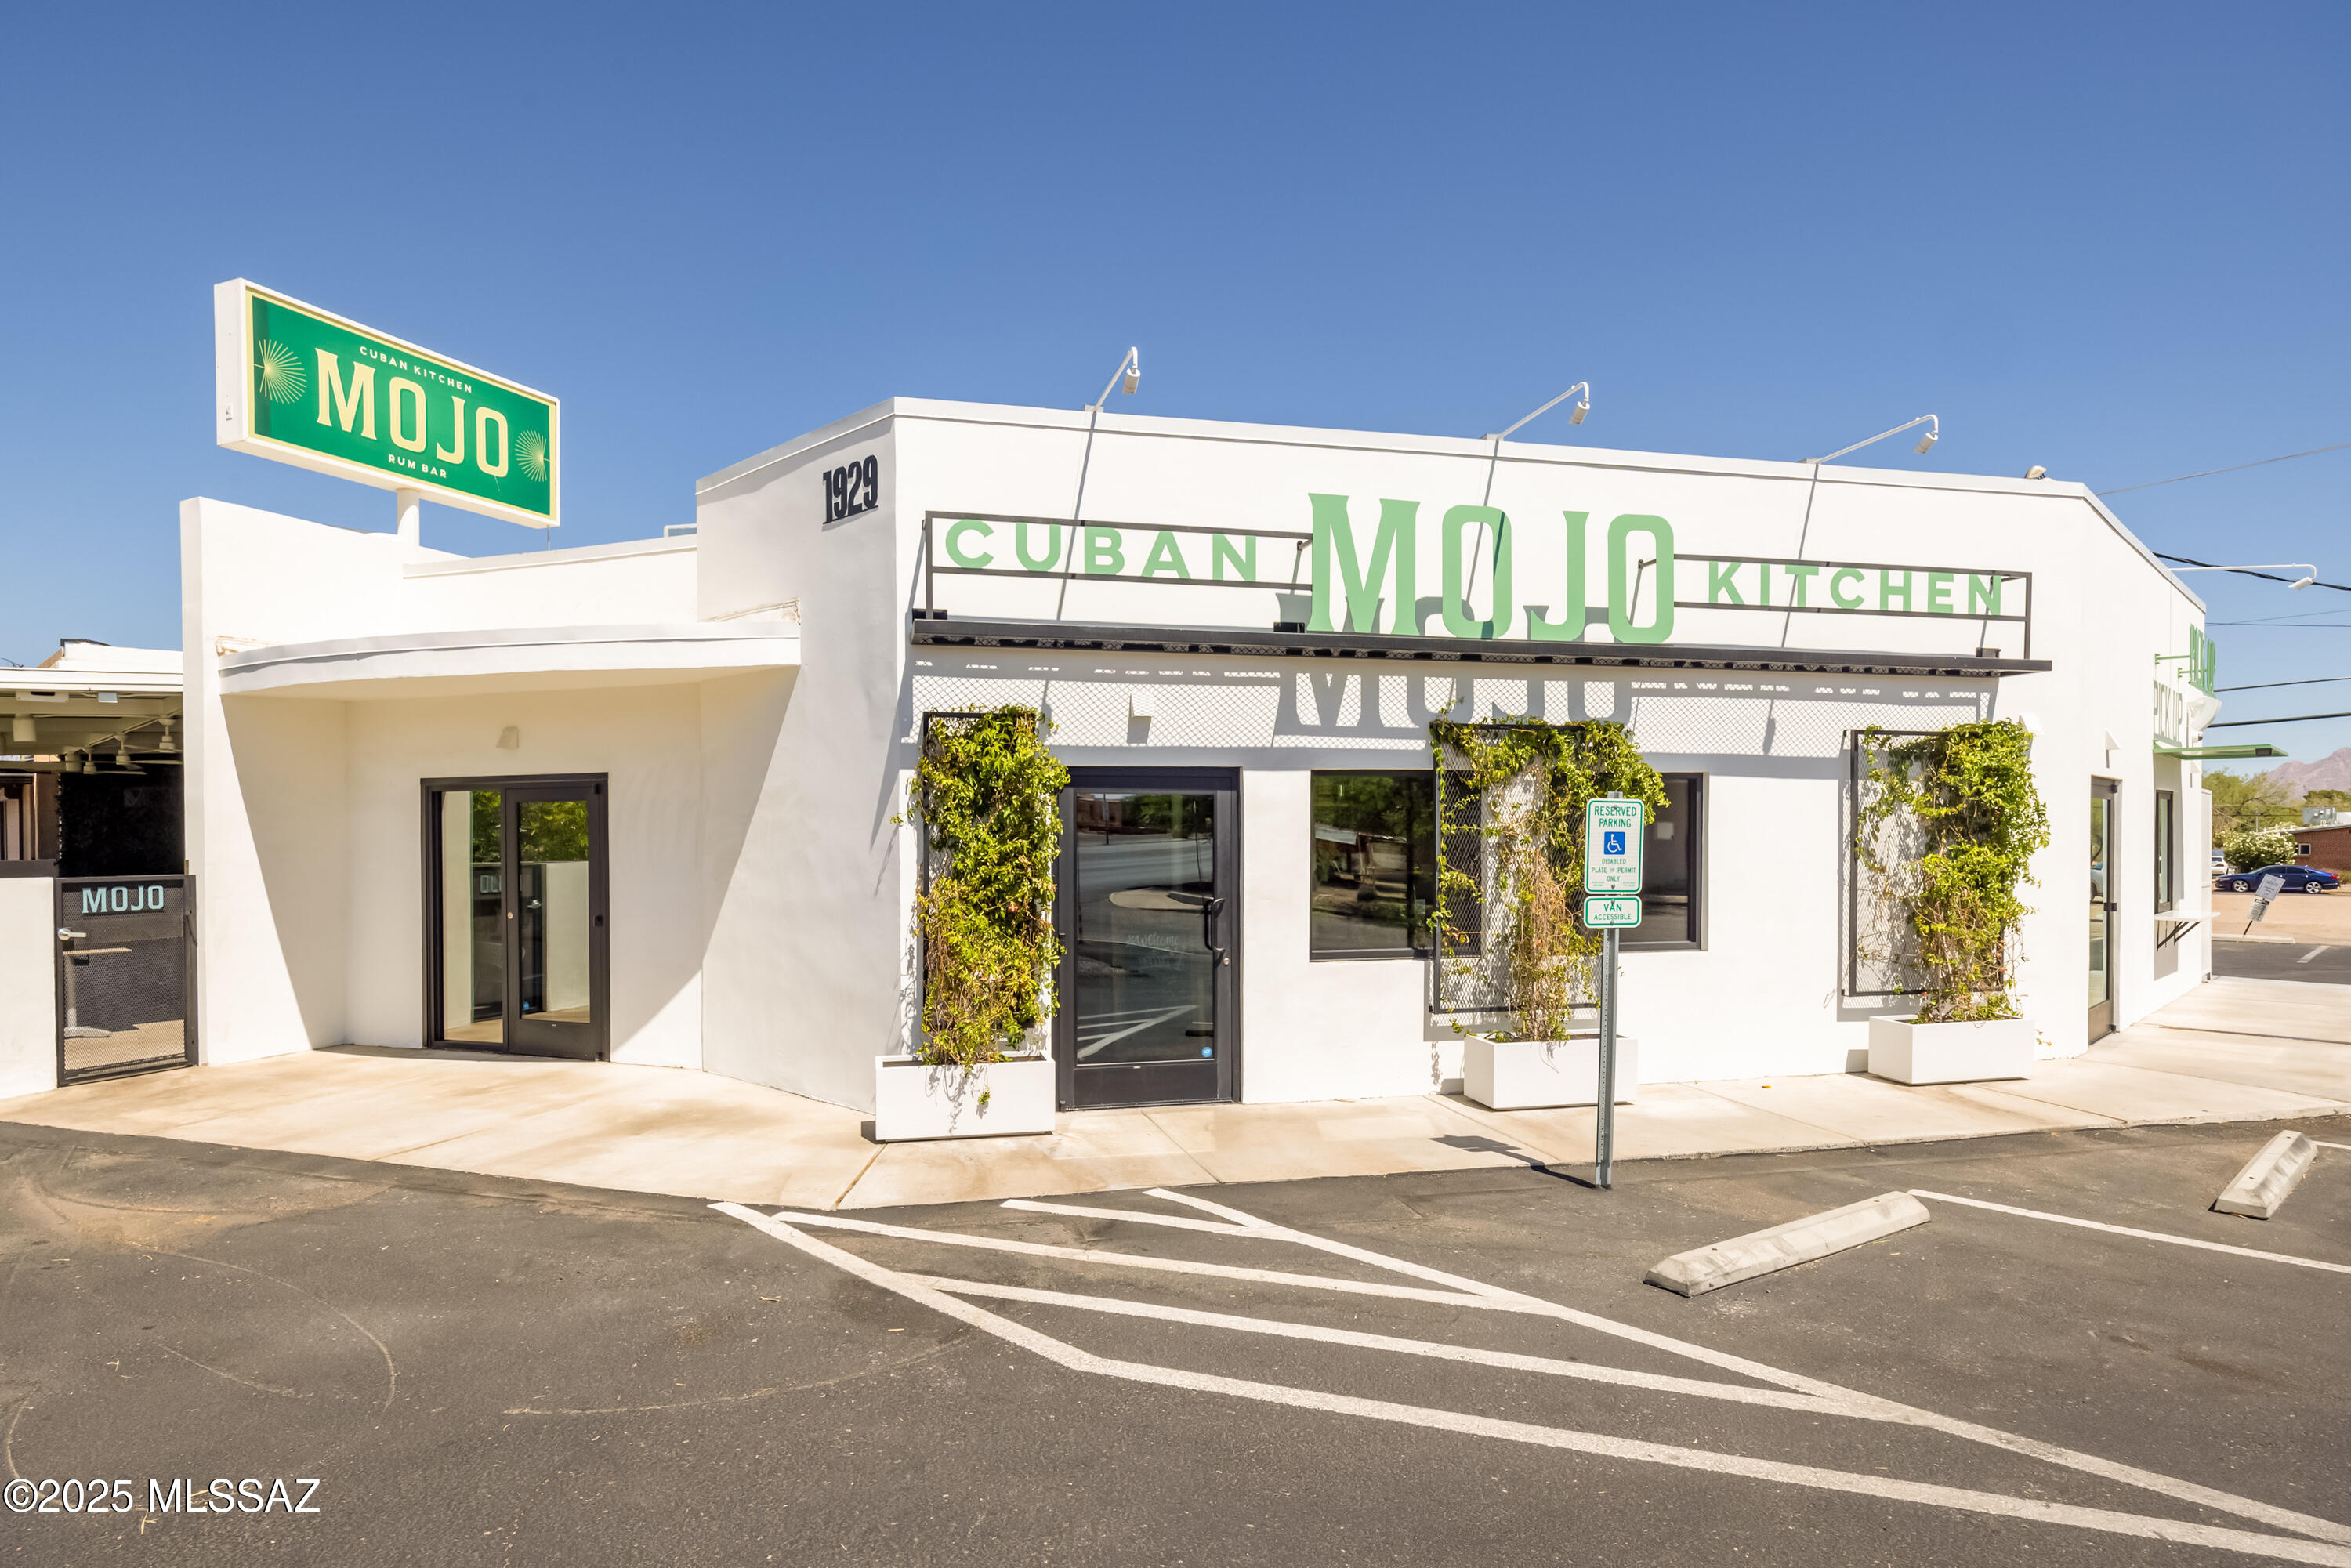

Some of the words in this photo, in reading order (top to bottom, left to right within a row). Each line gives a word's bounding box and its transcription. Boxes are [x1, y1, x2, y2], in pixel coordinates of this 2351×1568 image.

[360, 346, 408, 371] CUBAN
[413, 365, 473, 394] KITCHEN
[315, 347, 509, 478] MOJO
[388, 454, 417, 471] RUM
[422, 463, 447, 480] BAR
[823, 454, 878, 523] 1929
[945, 518, 1257, 582] CUBAN
[1306, 492, 1675, 644] MOJO
[1708, 560, 2002, 616] KITCHEN
[1594, 806, 1637, 817] RESERVED
[1599, 818, 1632, 828] PARKING
[82, 885, 165, 914] MOJO
[1603, 904, 1622, 913] VAN
